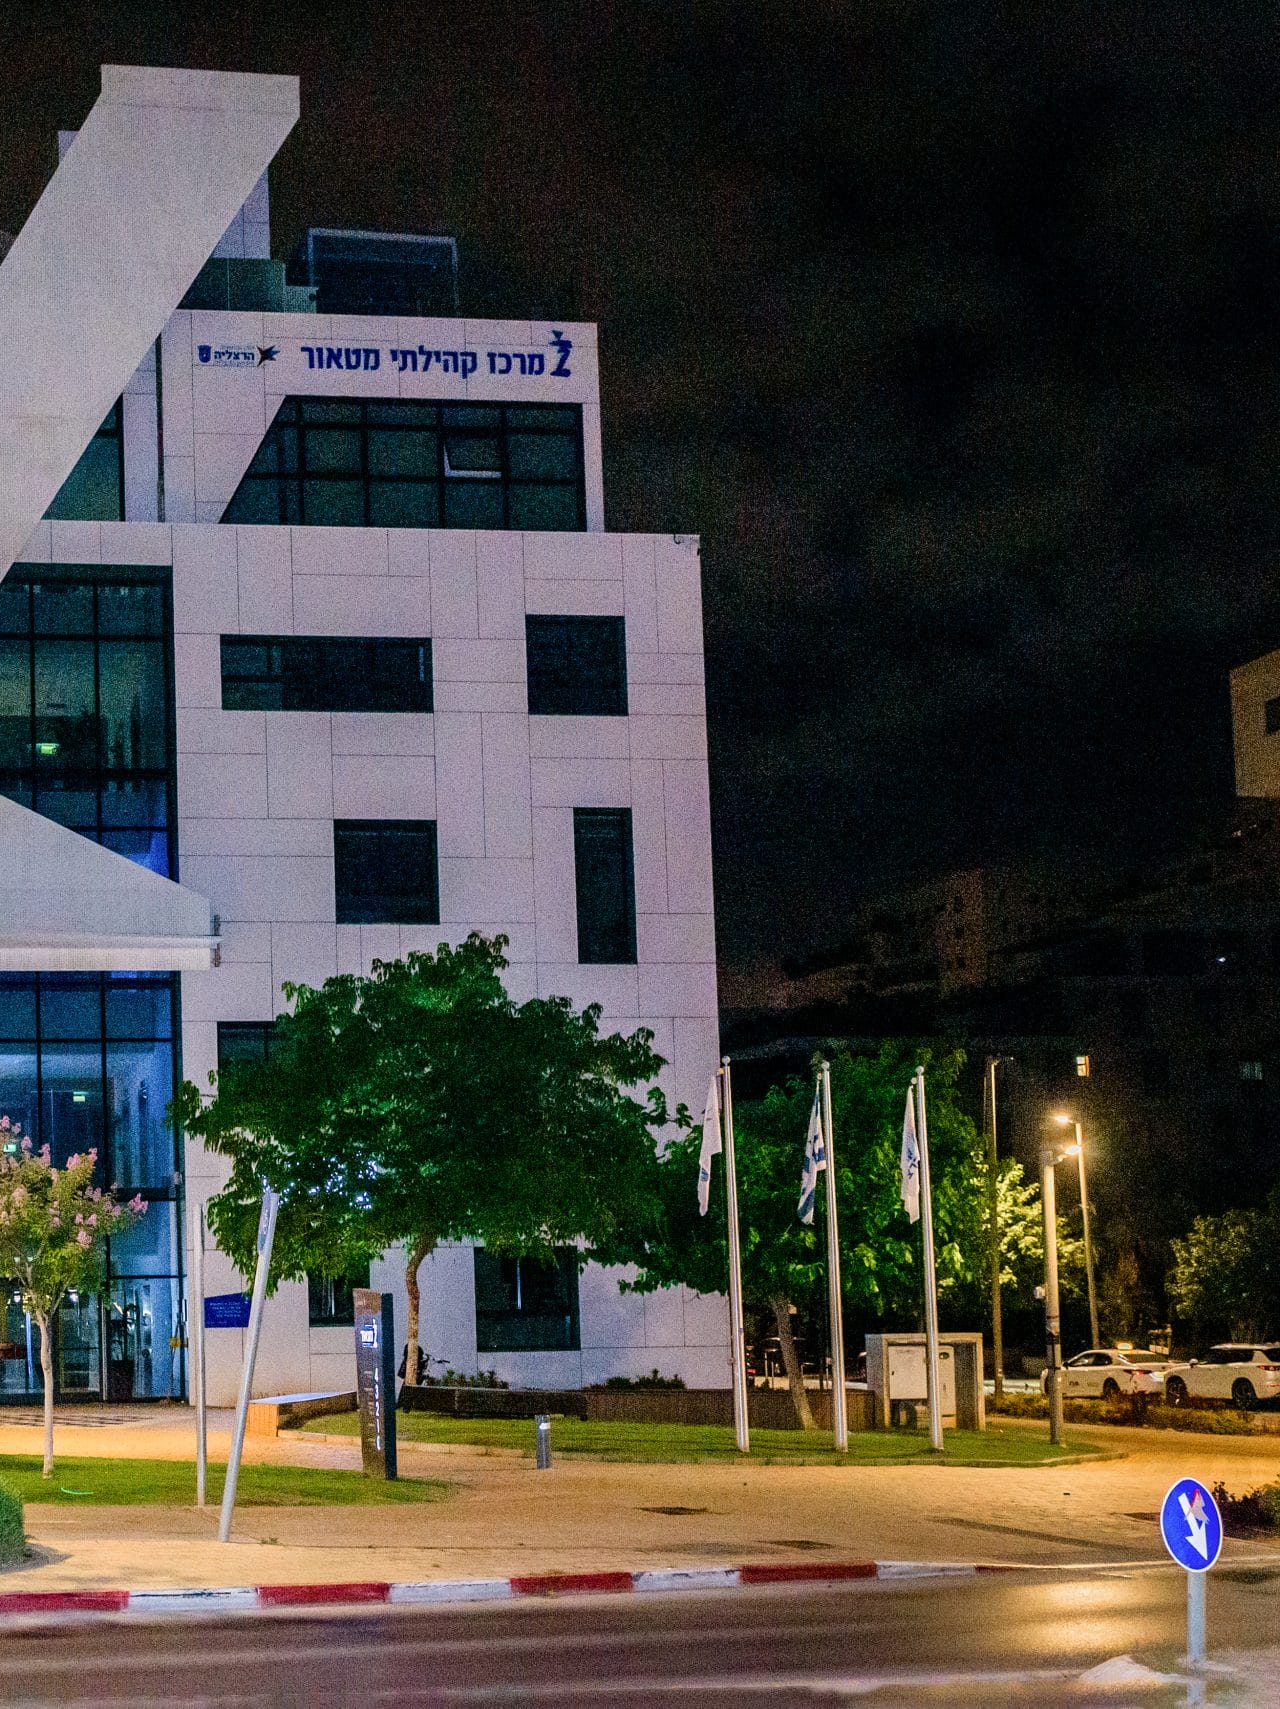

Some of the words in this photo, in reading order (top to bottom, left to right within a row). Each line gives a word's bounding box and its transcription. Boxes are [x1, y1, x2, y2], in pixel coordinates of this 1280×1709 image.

[214, 349, 255, 361] הרצליה
[300, 346, 380, 371] מטאור
[390, 345, 478, 379] קהילתי
[486, 352, 545, 375] מרכז
